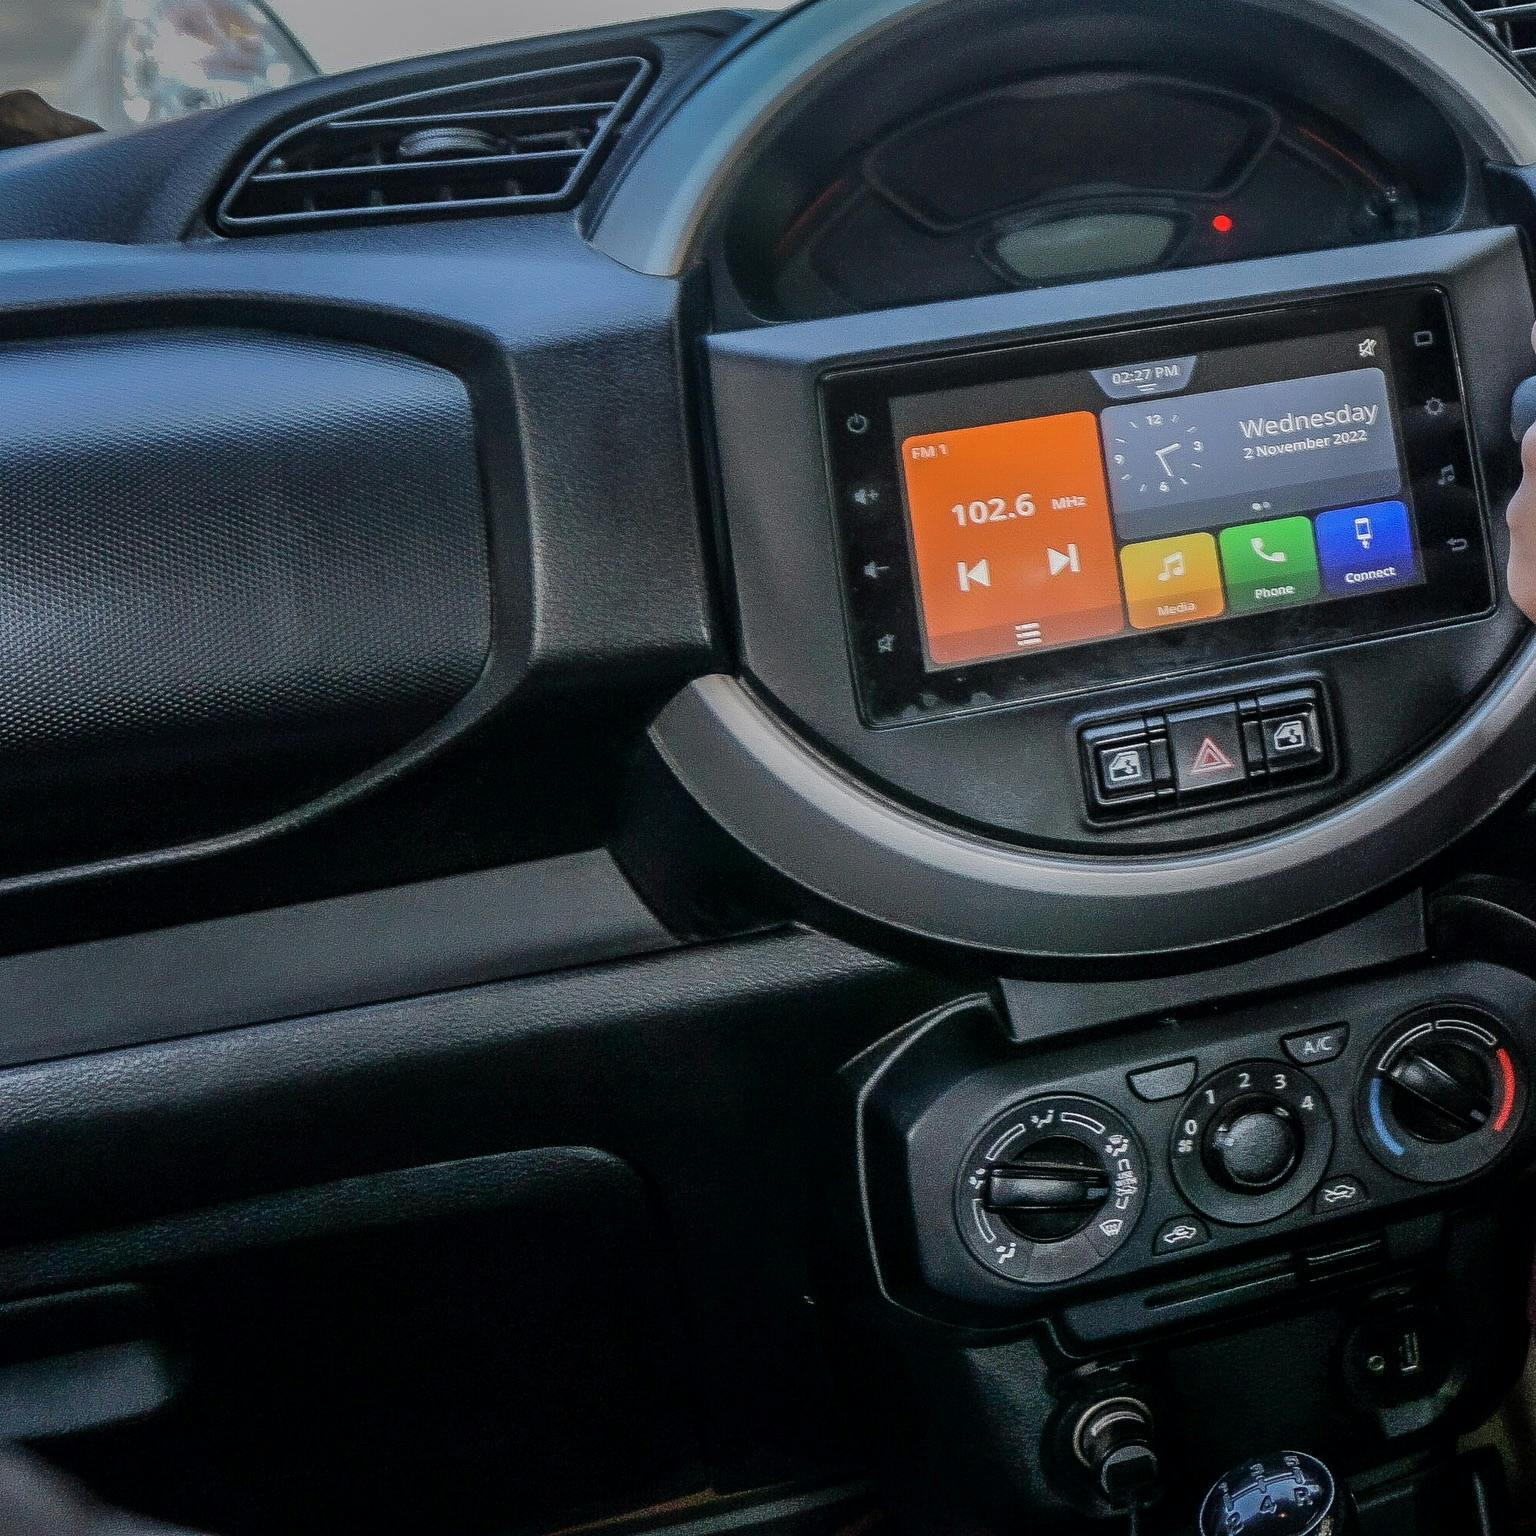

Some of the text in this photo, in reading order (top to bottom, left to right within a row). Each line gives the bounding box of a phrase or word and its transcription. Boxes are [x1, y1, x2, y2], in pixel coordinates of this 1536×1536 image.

[1112, 365, 1180, 385] 02:27 PM
[1146, 414, 1163, 426] 12
[1239, 403, 1379, 440] Wednesday
[911, 443, 948, 460] FM 1
[1242, 429, 1368, 460] 2 November 2022
[952, 492, 1087, 528] 102.6 MHz
[1344, 565, 1397, 584] Connect
[1255, 584, 1296, 600] Phone
[1157, 602, 1196, 617] Media
[1303, 1036, 1333, 1055] A/C
[1238, 1072, 1251, 1088] 2
[1273, 1074, 1288, 1090] 3
[1205, 1089, 1216, 1104] 1
[1301, 1095, 1314, 1111] 4
[1184, 1119, 1198, 1135] 0
